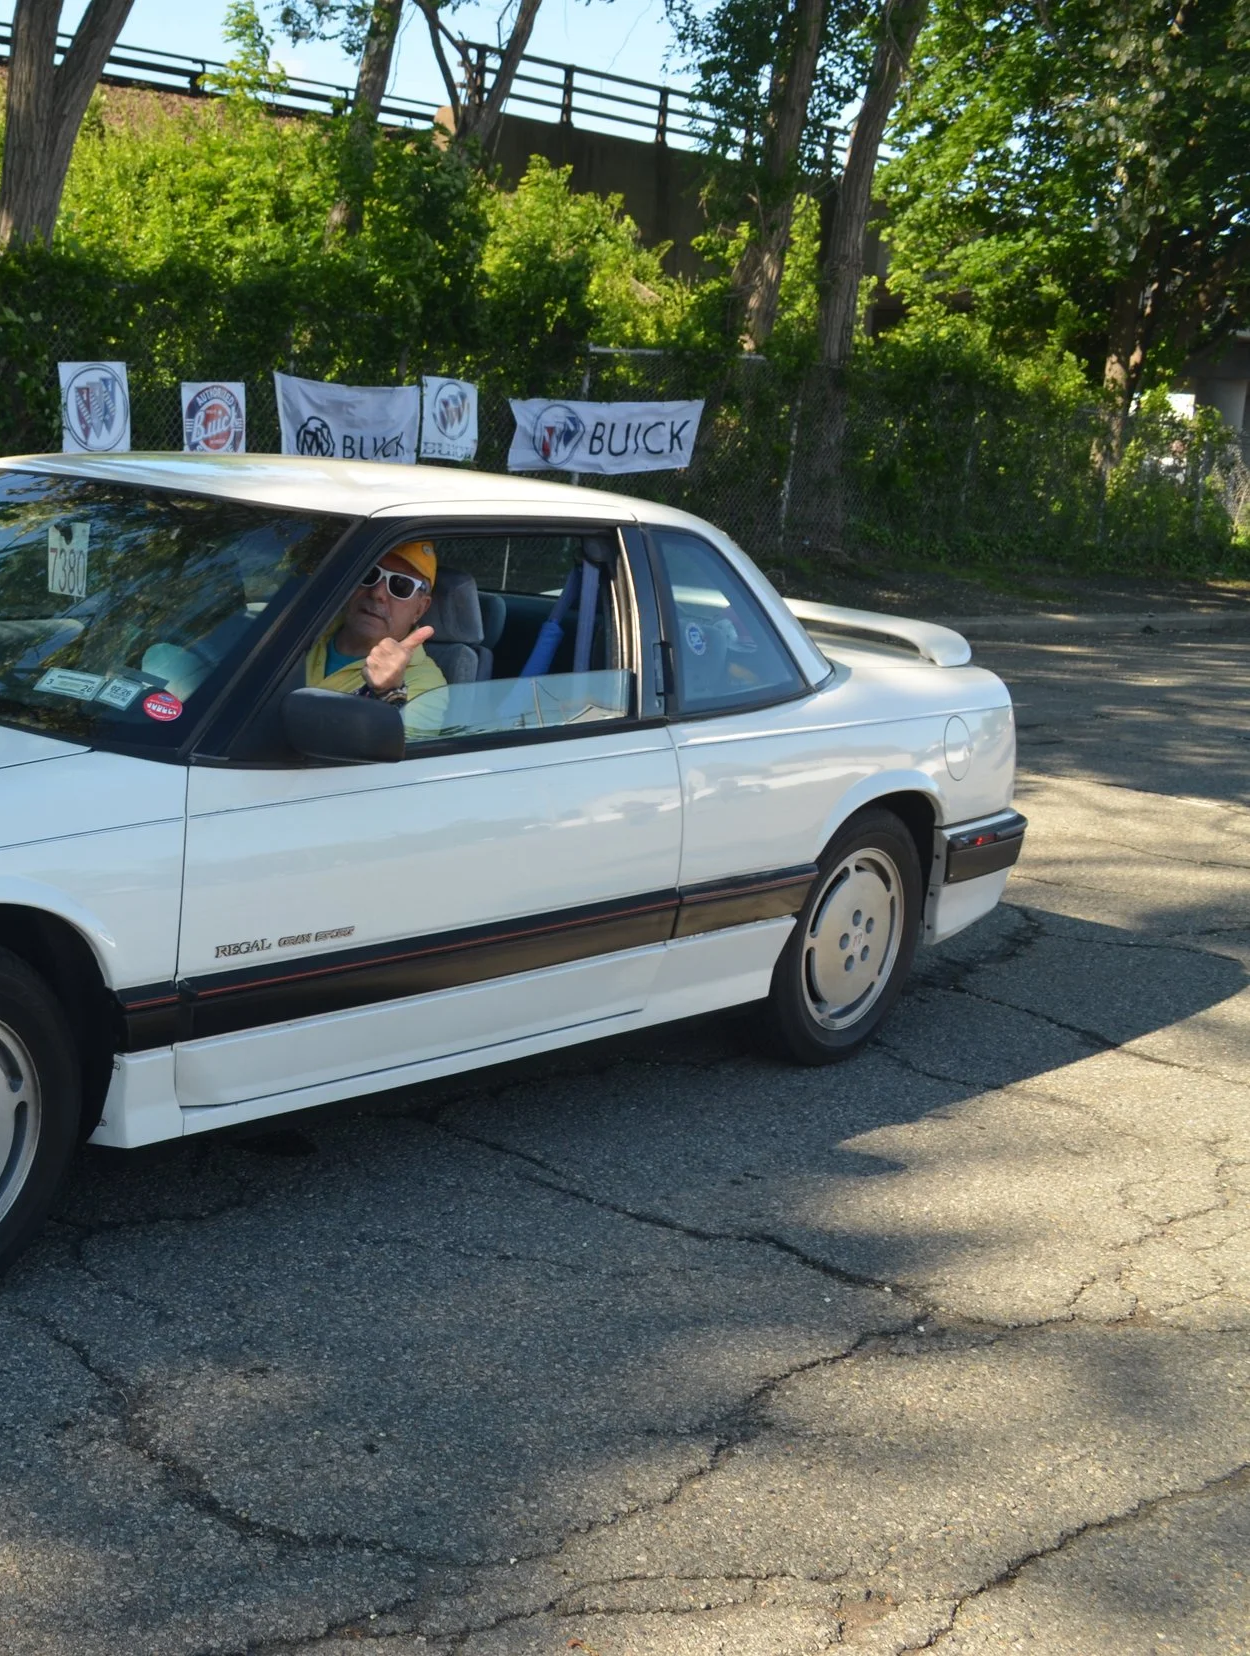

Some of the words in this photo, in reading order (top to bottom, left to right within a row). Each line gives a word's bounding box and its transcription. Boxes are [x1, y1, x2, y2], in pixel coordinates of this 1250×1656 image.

[589, 419, 691, 457] BUICK
[50, 547, 87, 595] 7380
[215, 938, 272, 958] REGAL
